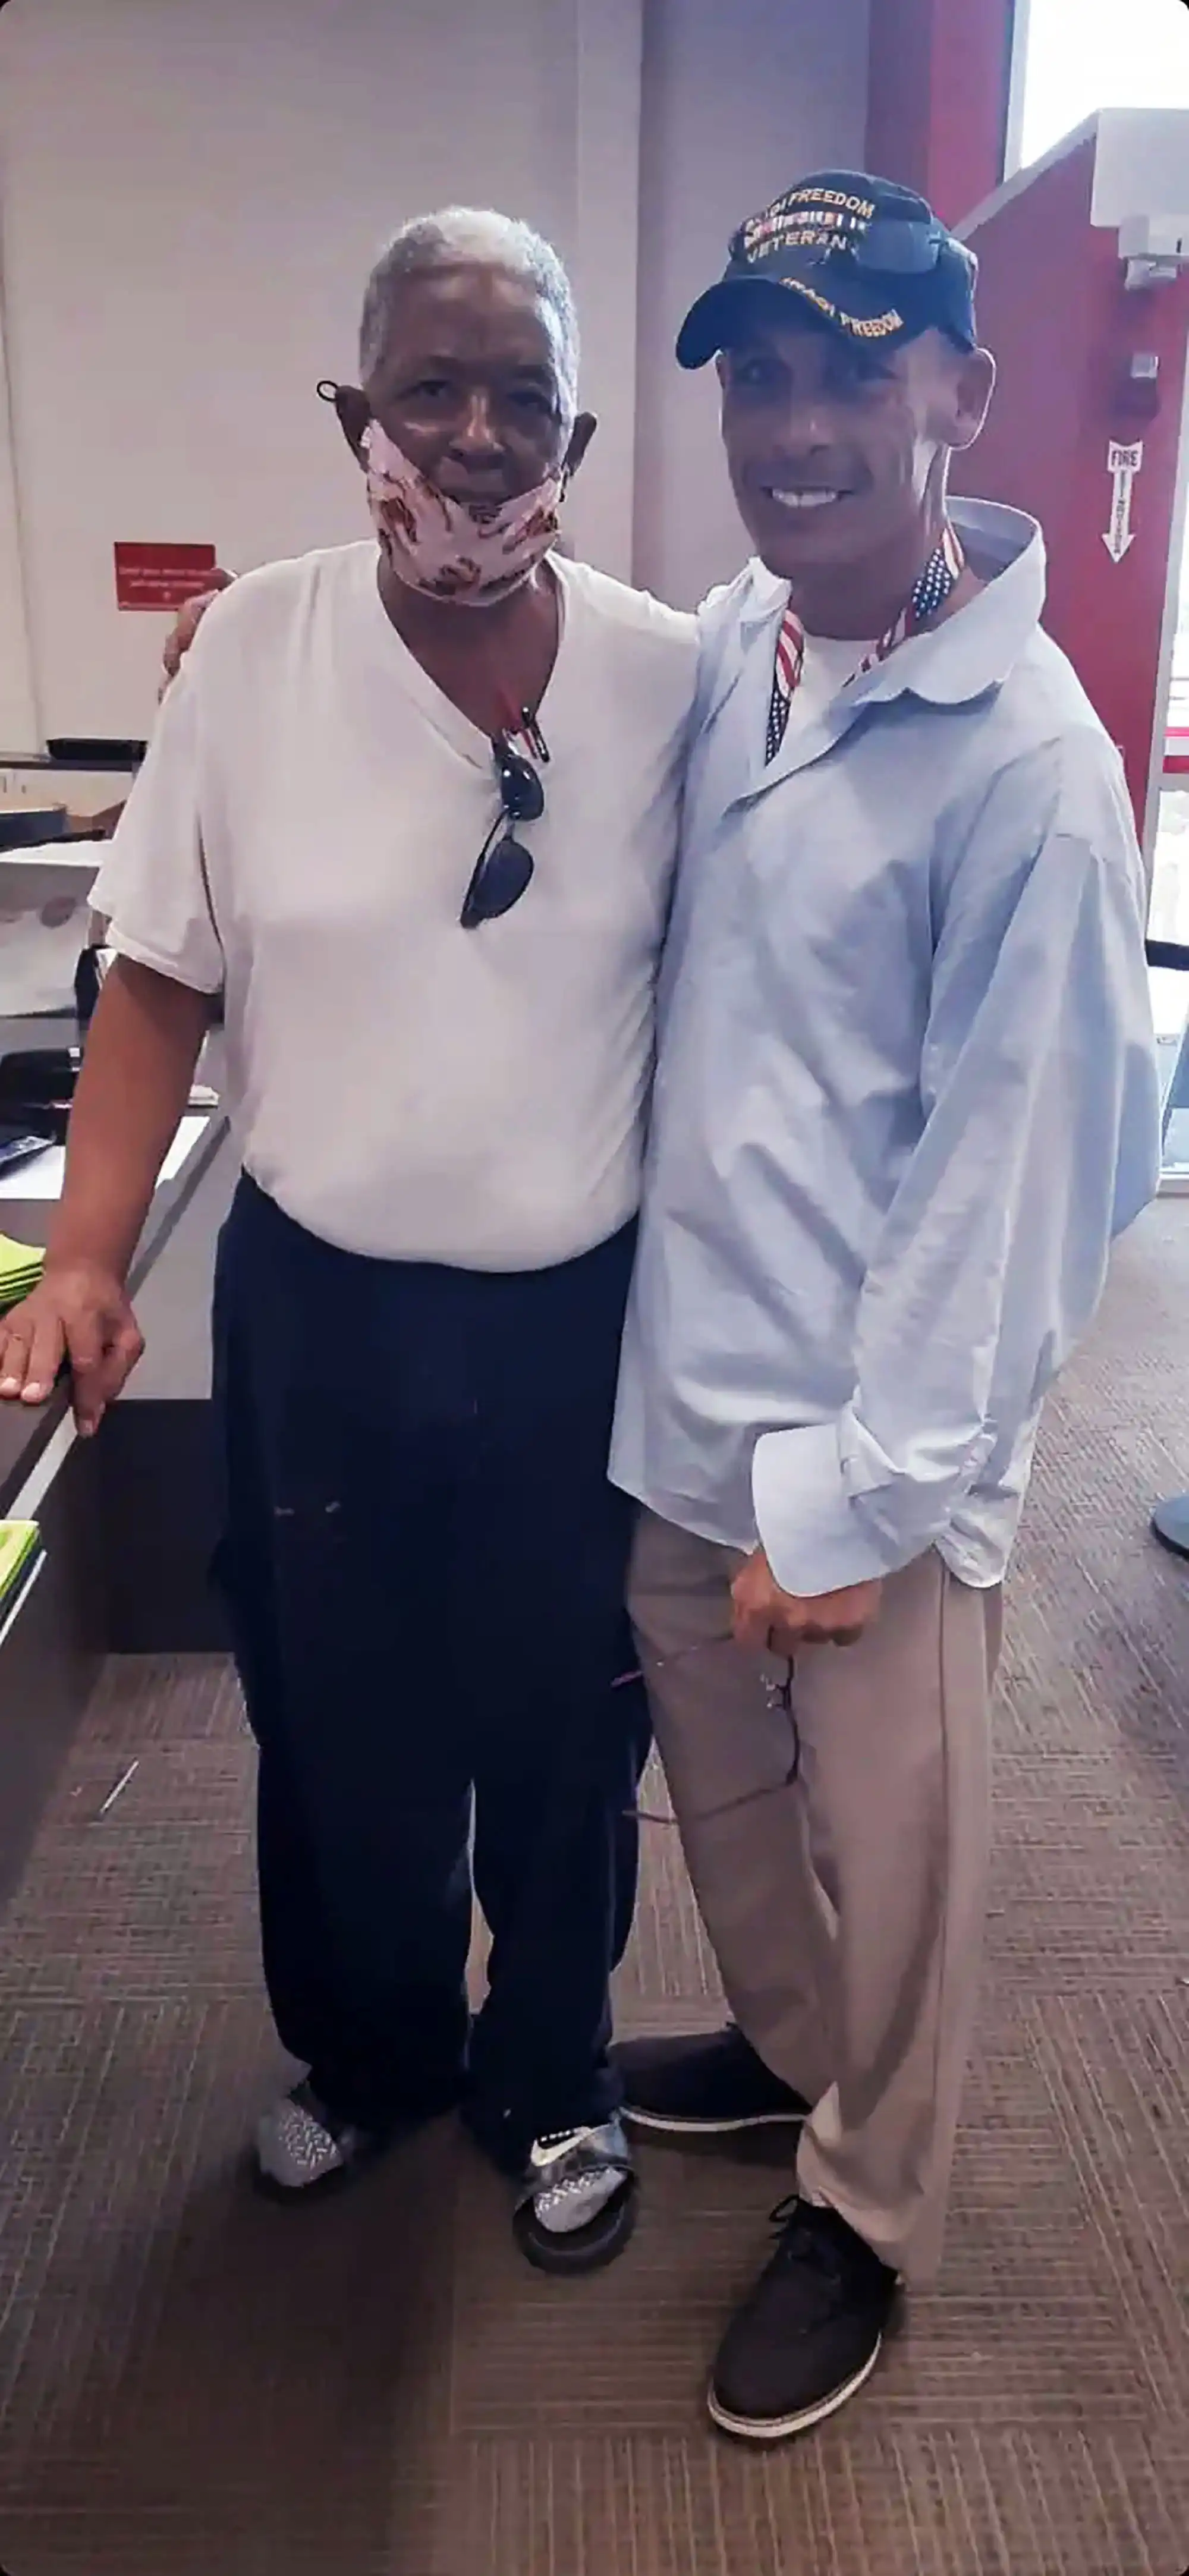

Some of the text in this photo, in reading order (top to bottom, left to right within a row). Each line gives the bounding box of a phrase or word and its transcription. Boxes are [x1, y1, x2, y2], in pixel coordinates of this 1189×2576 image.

[788, 187, 875, 219] FREEDOM
[747, 229, 847, 263] VETERAN
[839, 309, 904, 337] FREEDOM
[1111, 450, 1138, 467] FIRE
